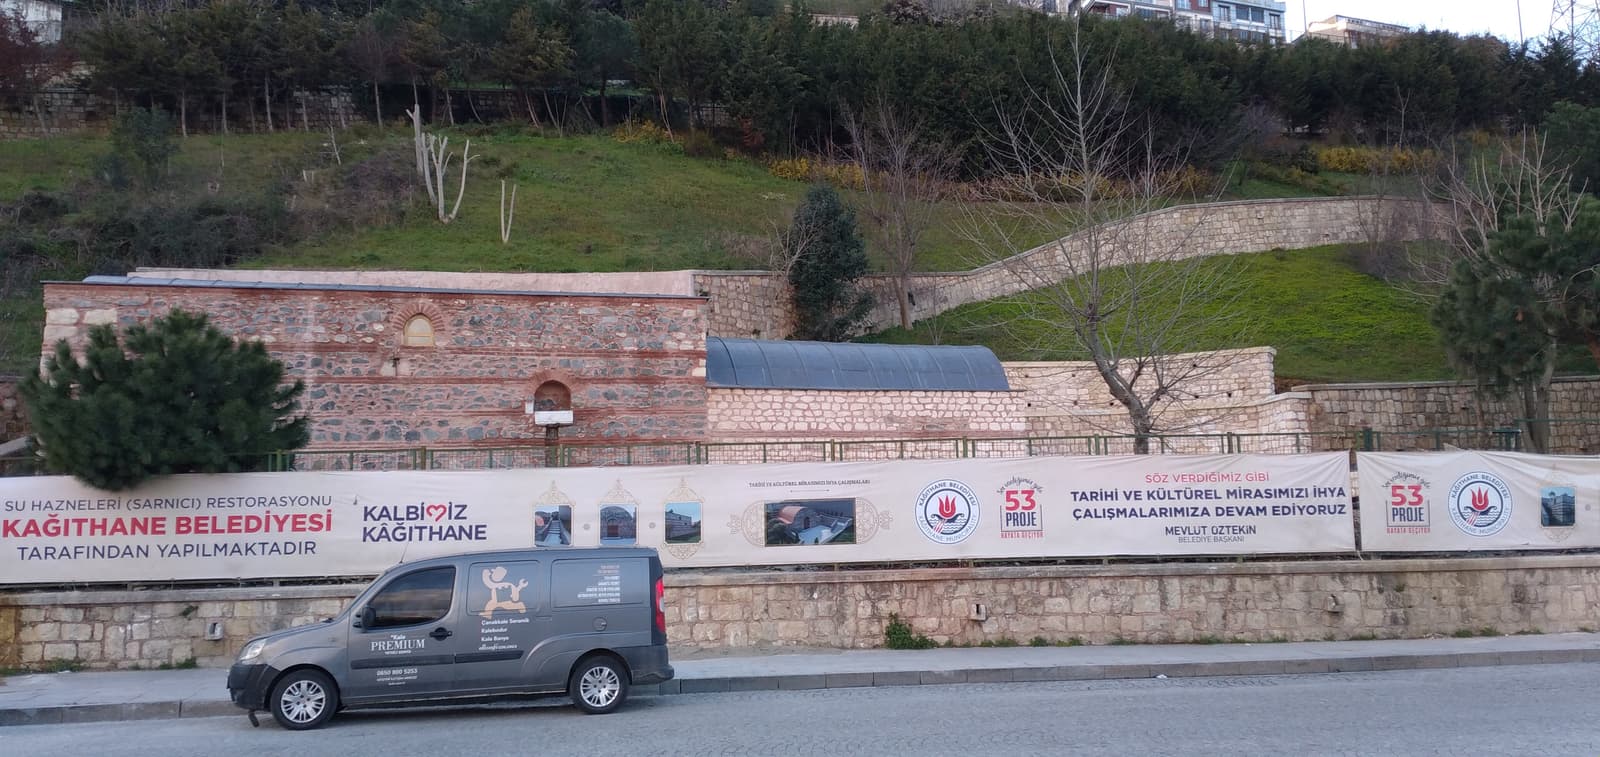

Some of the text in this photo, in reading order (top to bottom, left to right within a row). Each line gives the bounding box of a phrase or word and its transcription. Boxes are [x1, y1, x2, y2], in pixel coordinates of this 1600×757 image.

[1145, 471, 1269, 483] SÖZ VERDİĞİMİZ GİBİ
[1005, 490, 1036, 511] 53
[1070, 485, 1346, 501] TARİHİ VE KÜLTÜREL MİRASIMIZI İHYA
[1391, 485, 1424, 506] 53
[5, 495, 332, 512] SU HAZNELERİ (SARNICI) RESTORASYONU
[1072, 503, 1346, 520] ÇALIŞMALARIMIZA DEVAM EDİYORUZ
[1006, 511, 1037, 527] PROJE
[1392, 507, 1424, 522] PROJE
[2, 509, 332, 538] KAĞITHANE BELEDİYESİ
[362, 522, 487, 542] KÂĞITHANE
[17, 541, 316, 560] TARAFINDAN YAPILMAKTADIR
[371, 639, 425, 651] PREMIUM
